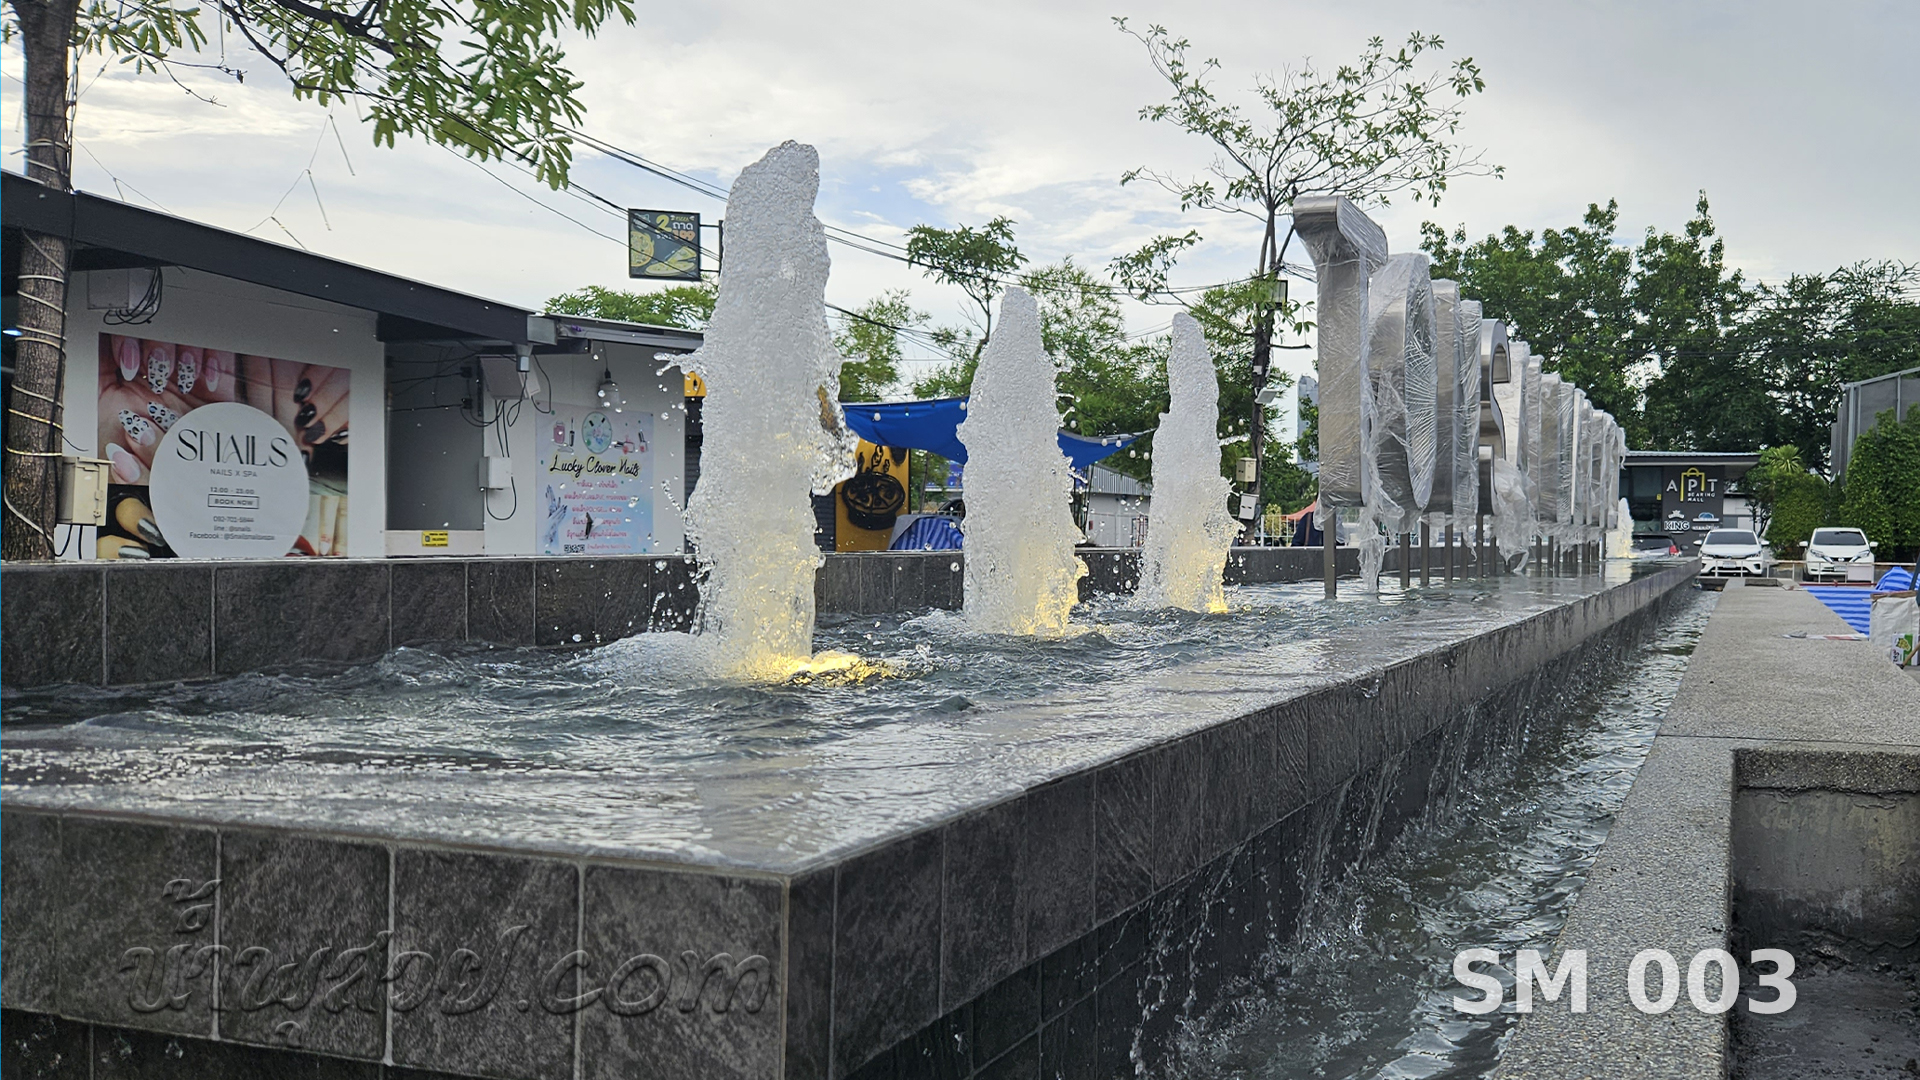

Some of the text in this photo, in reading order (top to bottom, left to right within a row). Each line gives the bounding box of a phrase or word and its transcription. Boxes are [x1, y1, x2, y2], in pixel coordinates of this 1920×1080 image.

[655, 214, 694, 233] 2 ถาด
[176, 429, 288, 467] SNAILS
[210, 468, 233, 477] NAILS
[549, 455, 640, 478] Lucky Clover Nails
[1664, 521, 1690, 531] KING
